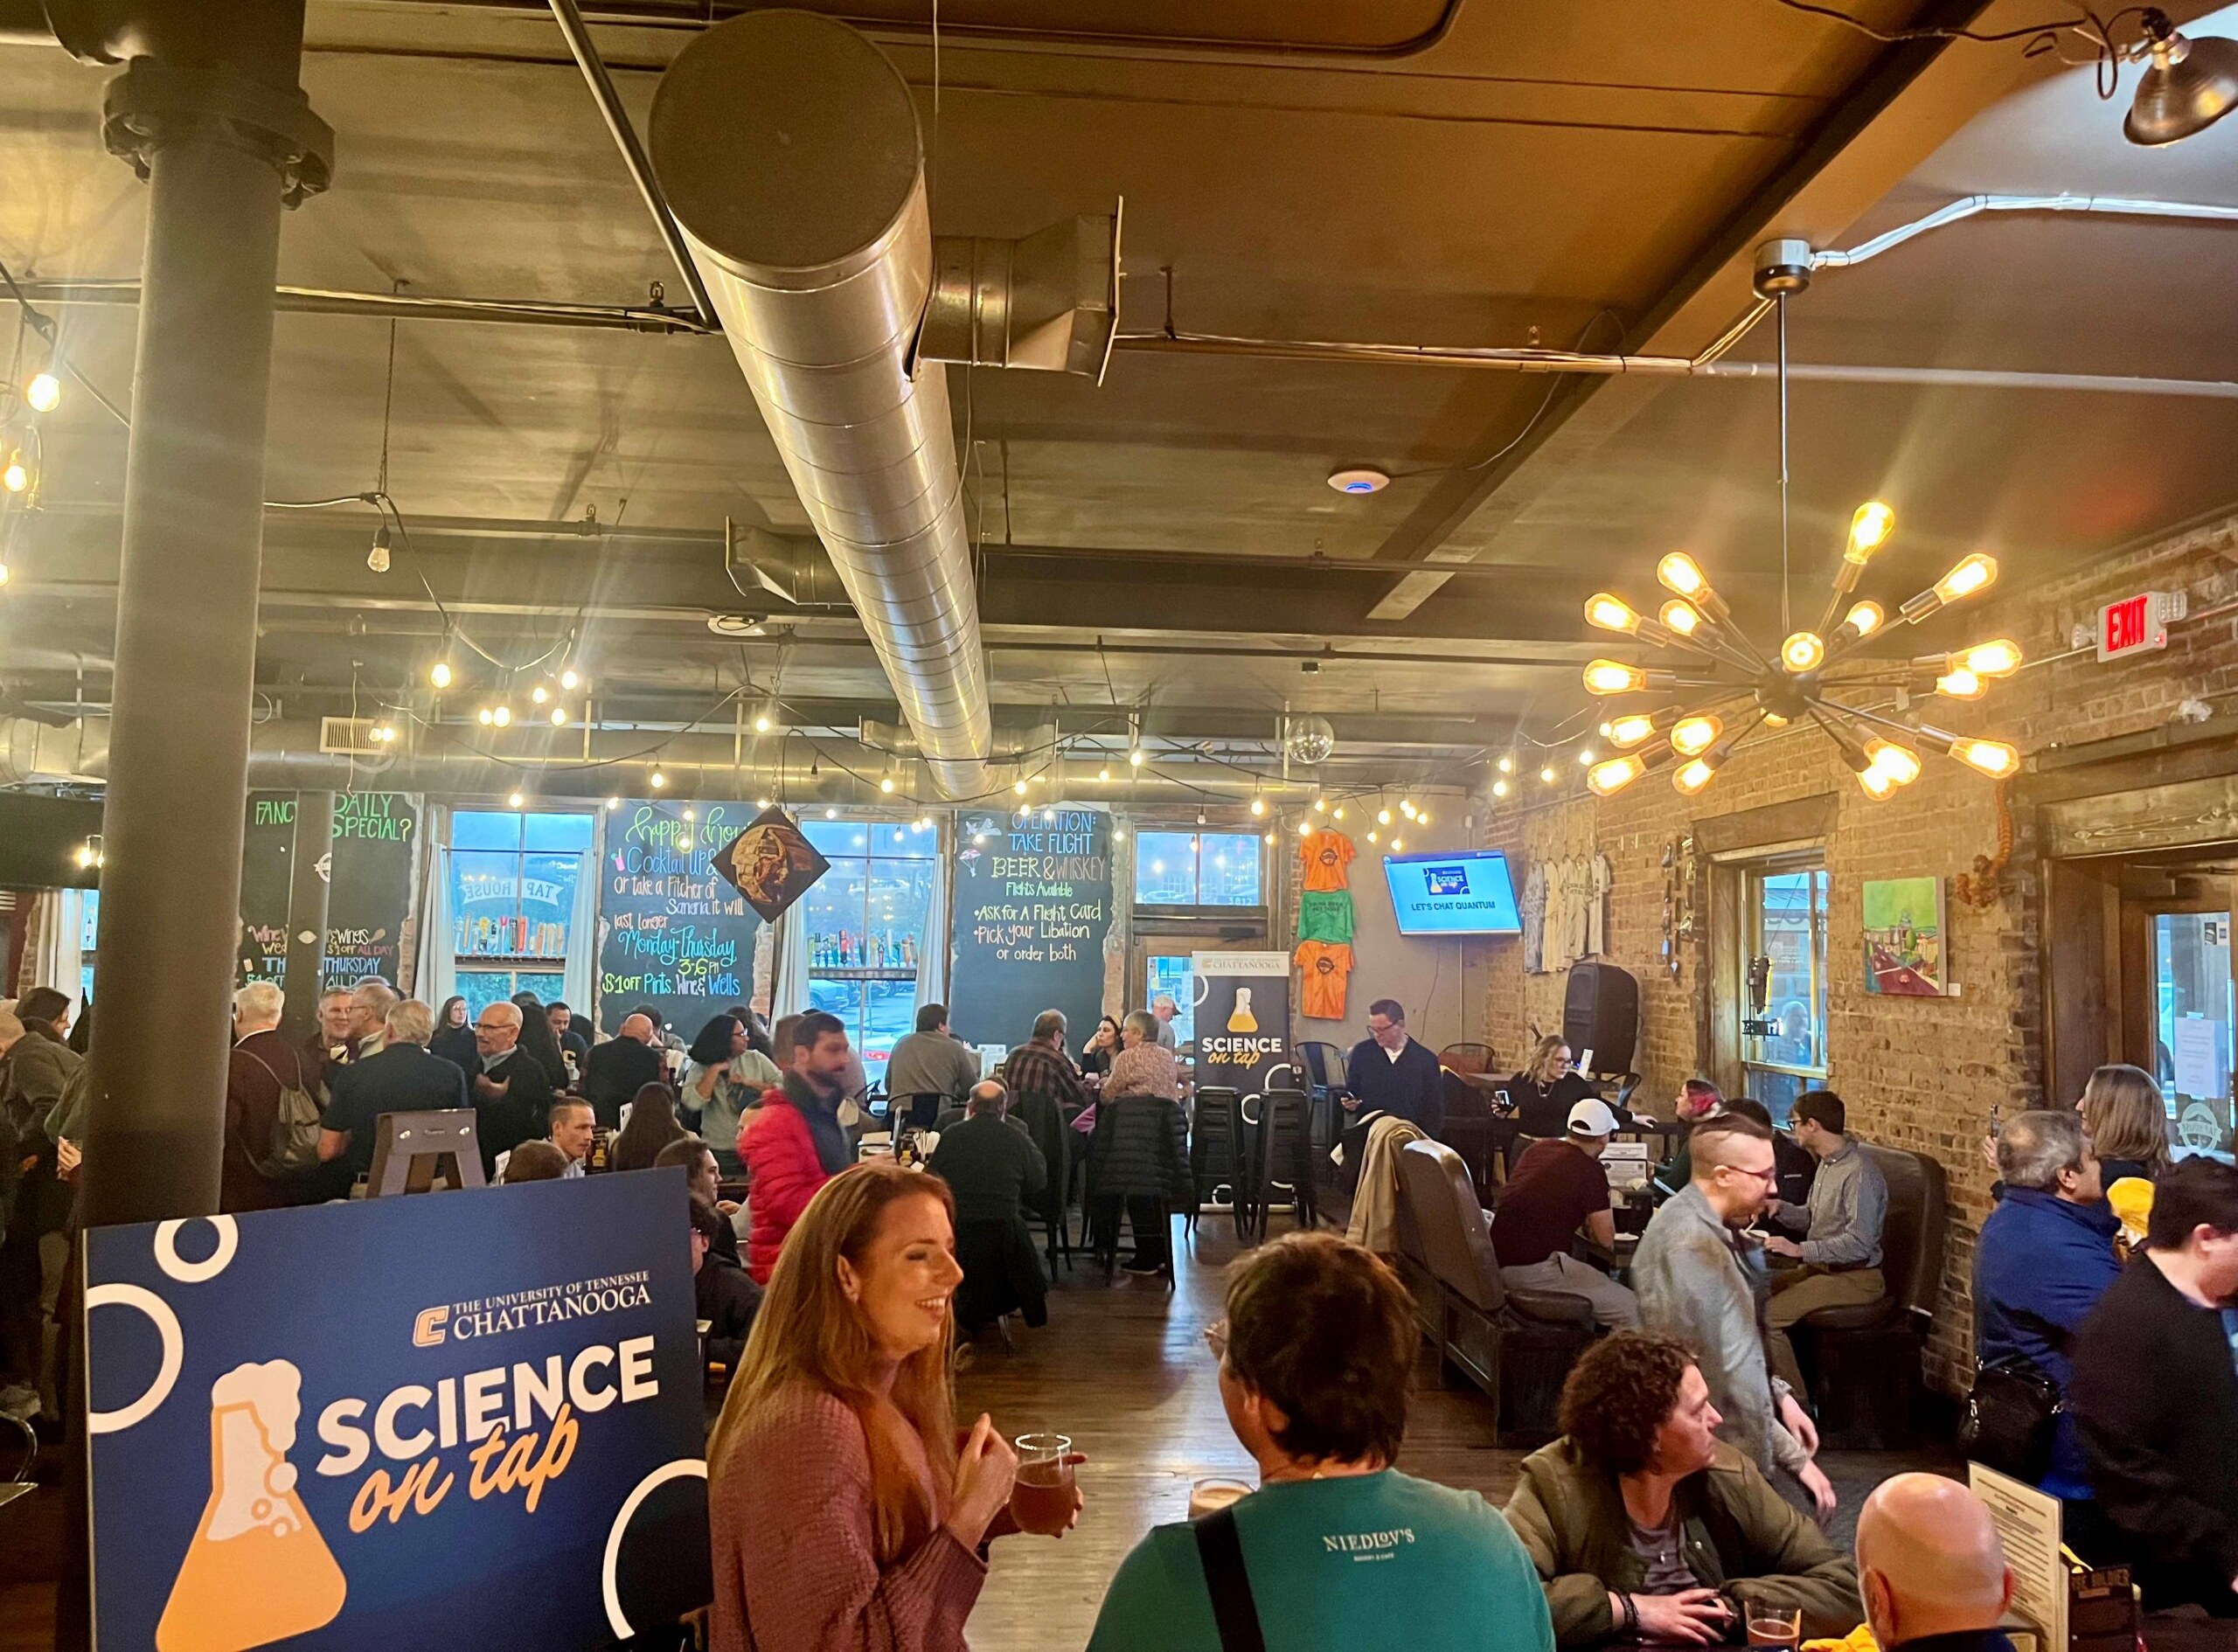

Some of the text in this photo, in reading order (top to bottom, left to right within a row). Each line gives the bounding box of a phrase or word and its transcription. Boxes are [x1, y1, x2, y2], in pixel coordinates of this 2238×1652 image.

[2106, 595, 2147, 652] EXIT
[333, 794, 393, 818] DAILY
[332, 813, 413, 843] SPECIAL?
[1008, 833, 1094, 855] TAKE FLIGHT
[627, 846, 685, 874] Cocktail
[991, 857, 1040, 878] BEER
[632, 875, 654, 896] take
[656, 879, 664, 896] a
[667, 875, 705, 899] Pitcher
[705, 877, 719, 899] of
[1006, 881, 1035, 897] Flights
[724, 898, 744, 915] will
[1001, 905, 1018, 921] for
[1020, 906, 1030, 921] A
[1033, 905, 1067, 921] Flight
[1070, 899, 1102, 921] Card
[1456, 901, 1496, 910] QUANTUM
[614, 913, 633, 930] last
[977, 921, 1090, 946] Pick your Libation
[997, 943, 1076, 961] or order both
[323, 956, 381, 975] THURSDAY
[708, 973, 740, 996] Wells
[1201, 1038, 1282, 1052] SCIENCE
[1207, 1048, 1261, 1070] on tap
[453, 1271, 650, 1315] THE UNIVERSITY OF TENNESSEE
[454, 1284, 651, 1340] CHATTANOOGA
[316, 1335, 659, 1476] SCIENCE
[349, 1403, 579, 1533] on tap
